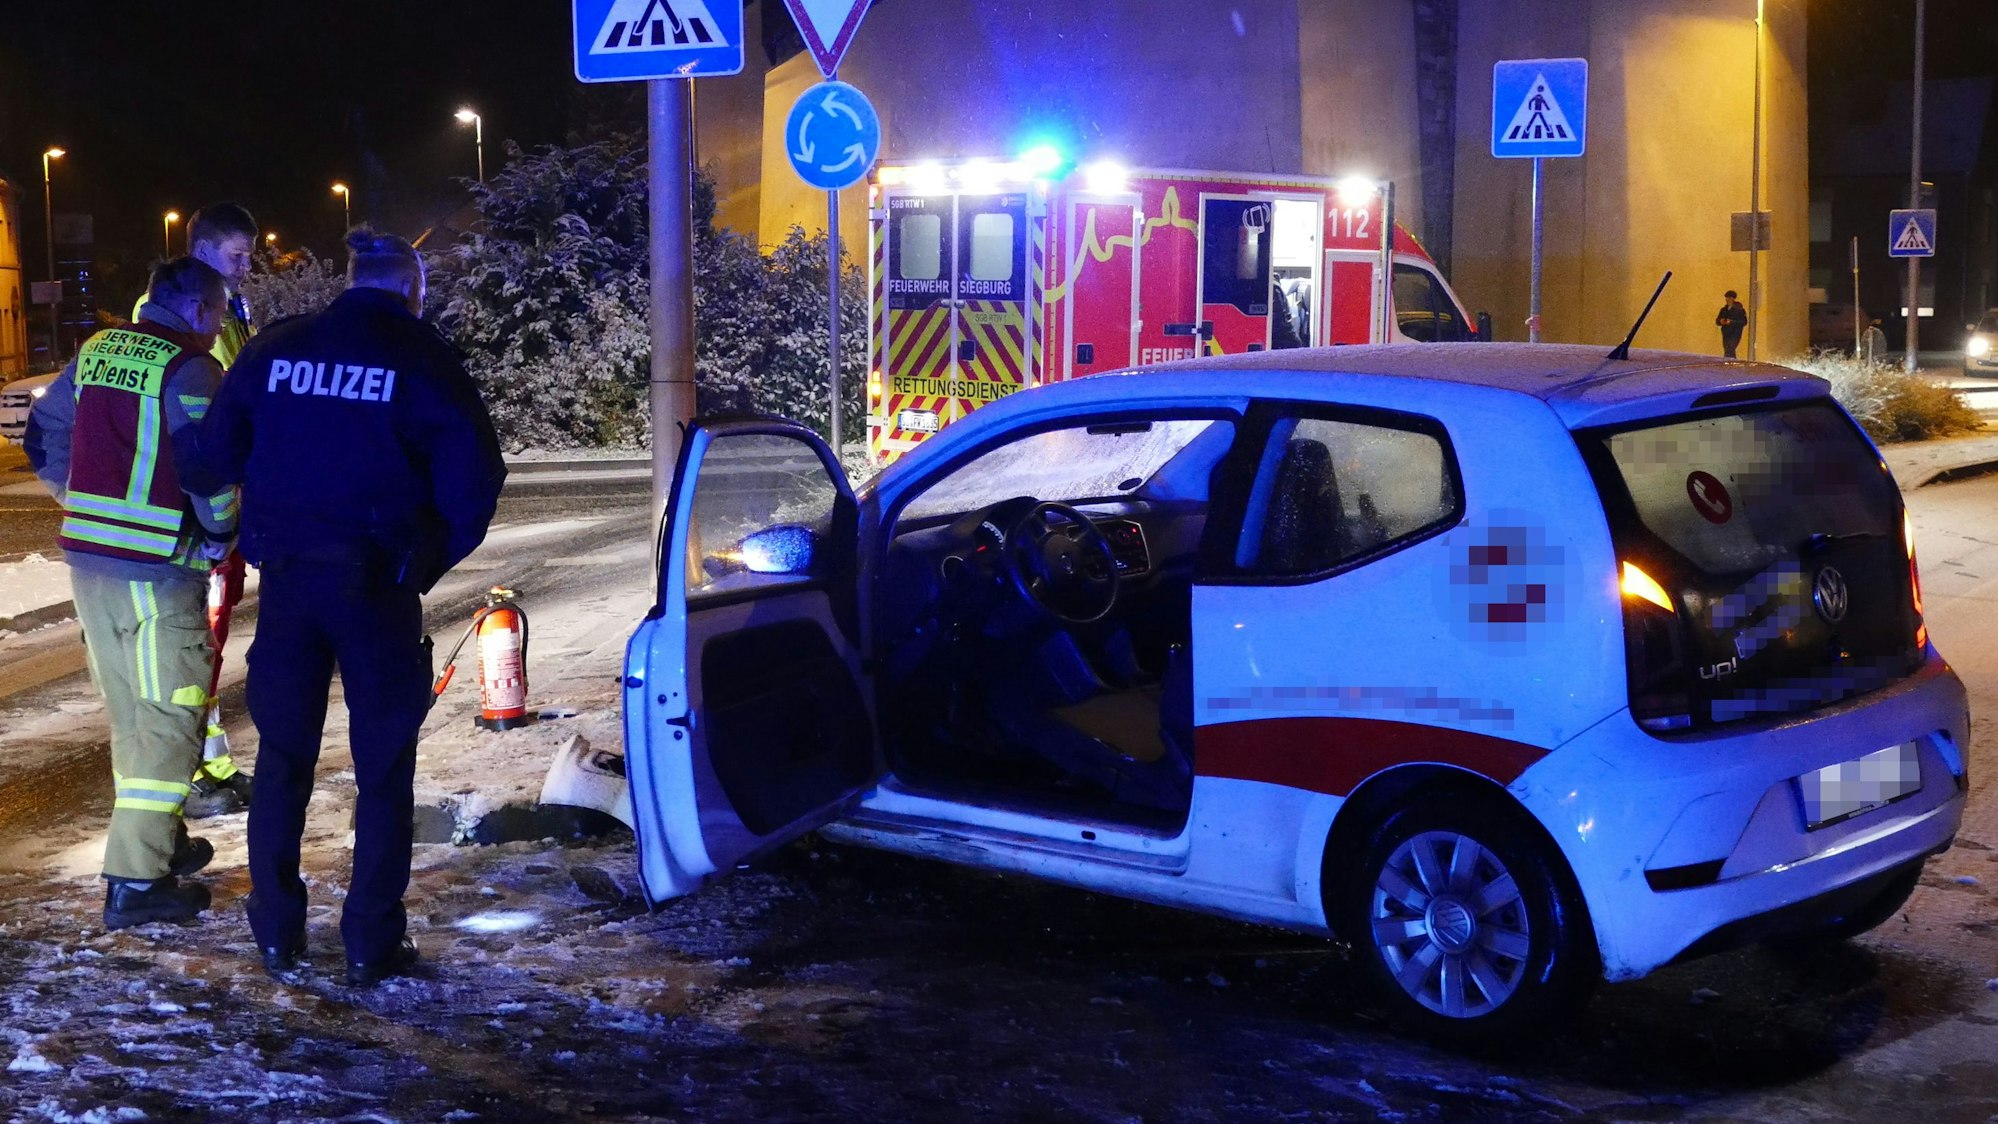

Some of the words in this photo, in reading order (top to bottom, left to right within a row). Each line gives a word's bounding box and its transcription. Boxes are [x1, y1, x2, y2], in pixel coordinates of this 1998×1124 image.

[891, 200, 904, 209] SGB
[905, 199, 920, 209] RTW
[1328, 207, 1369, 238] 112
[889, 280, 949, 293] FEUERWEHR
[960, 281, 1012, 295] SIEGBURG
[87, 342, 158, 360] SIEGBURG
[81, 357, 149, 391] C-Dienst
[267, 359, 396, 402] POLIZEI
[893, 377, 1018, 399] RETTUNGSDIENST
[1700, 656, 1738, 681] up!
